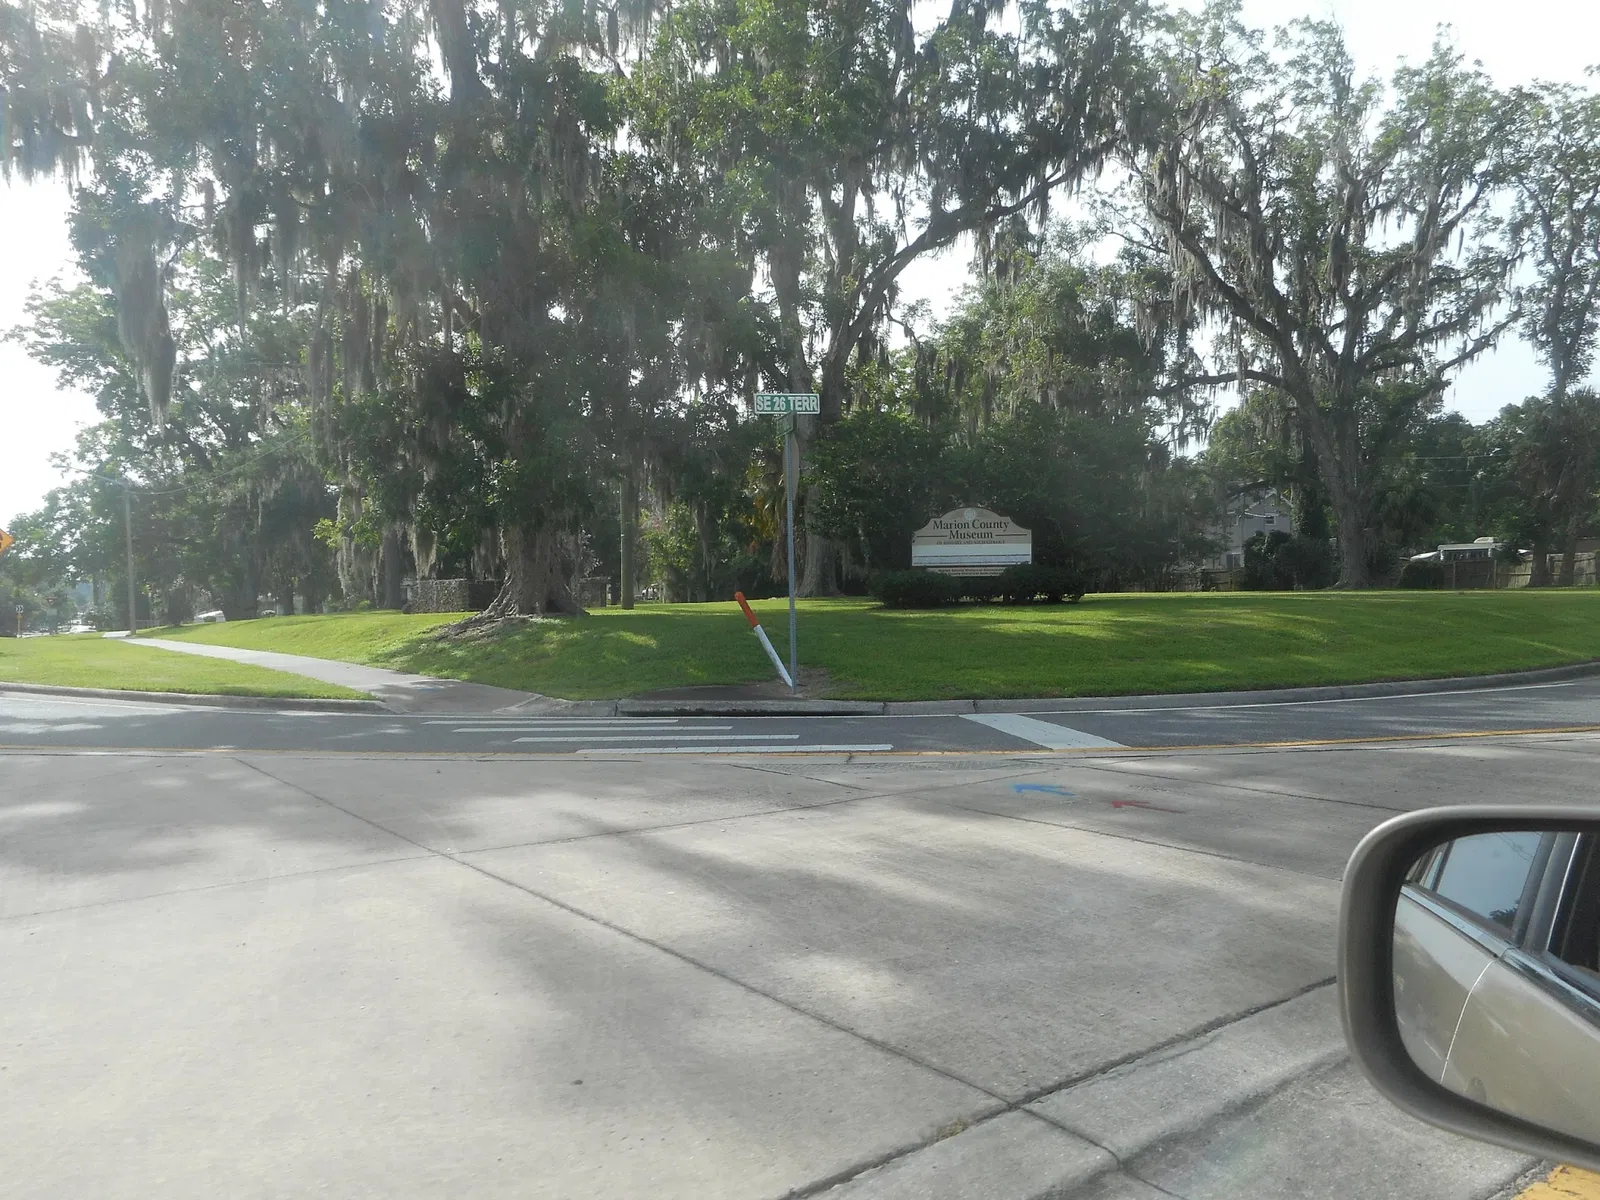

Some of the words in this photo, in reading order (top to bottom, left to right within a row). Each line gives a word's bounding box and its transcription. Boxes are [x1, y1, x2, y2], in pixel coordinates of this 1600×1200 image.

[756, 395, 771, 411] SE
[773, 396, 786, 411] 26
[787, 396, 818, 411] TERR
[933, 520, 969, 529] Marion
[972, 519, 1009, 531] County
[949, 530, 992, 539] Museum
